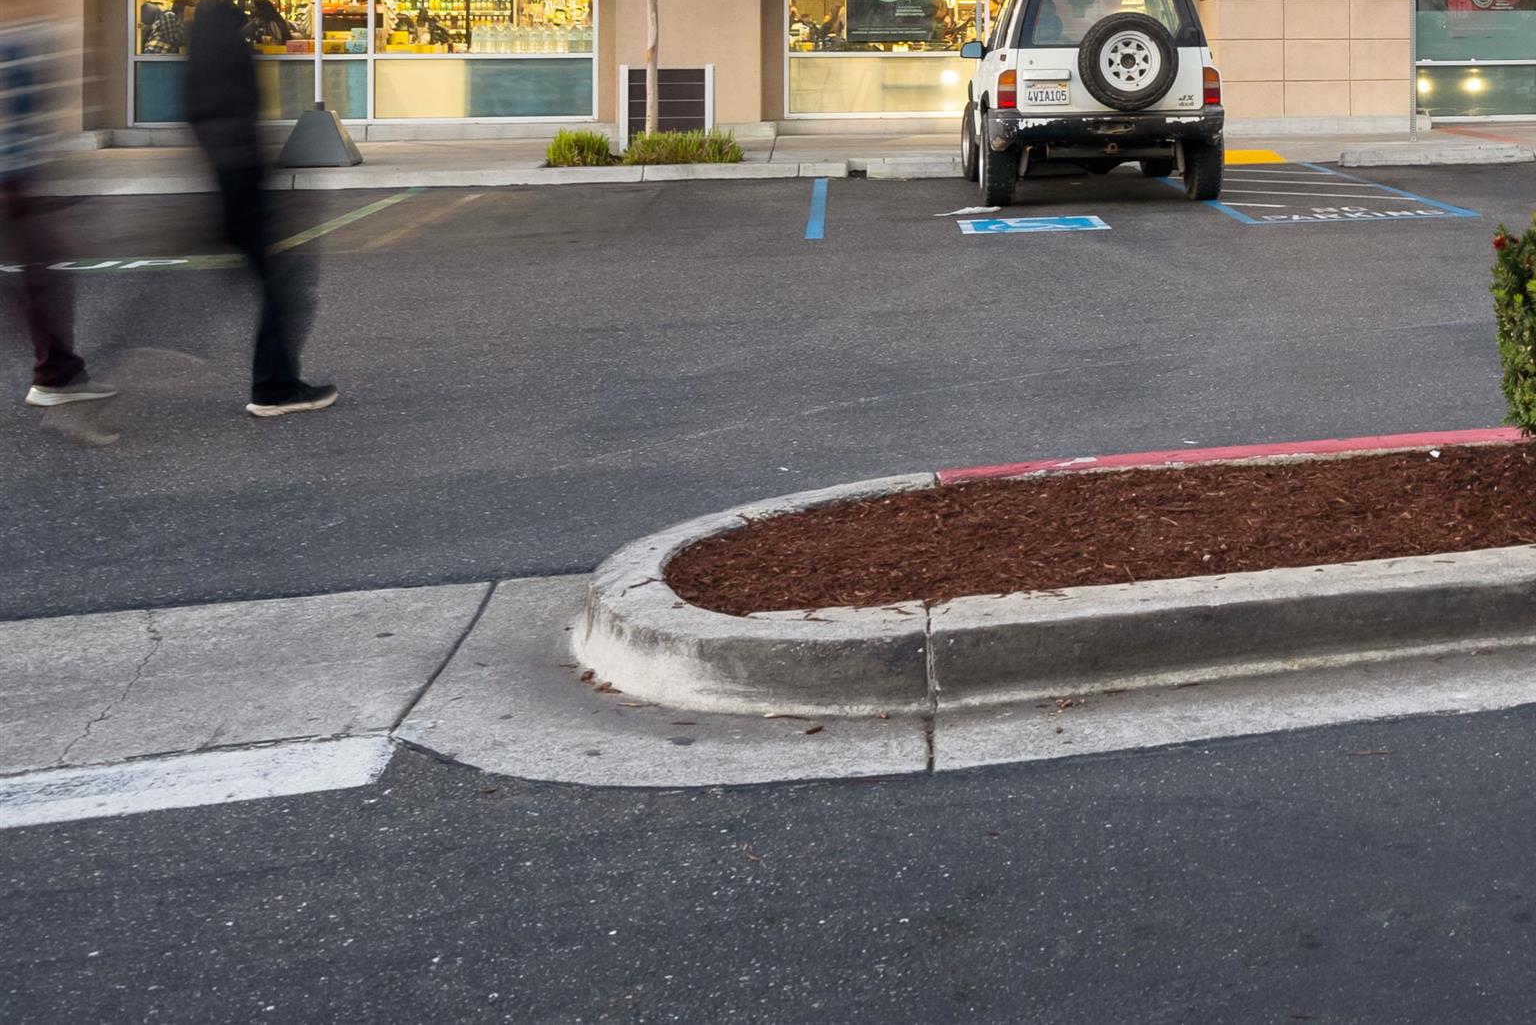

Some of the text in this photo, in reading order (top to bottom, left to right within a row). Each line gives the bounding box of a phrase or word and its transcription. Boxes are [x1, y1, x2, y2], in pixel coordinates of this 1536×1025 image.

[1027, 90, 1067, 102] 4VIA105
[1261, 209, 1444, 221] PARKING
[1310, 205, 1368, 213] NO
